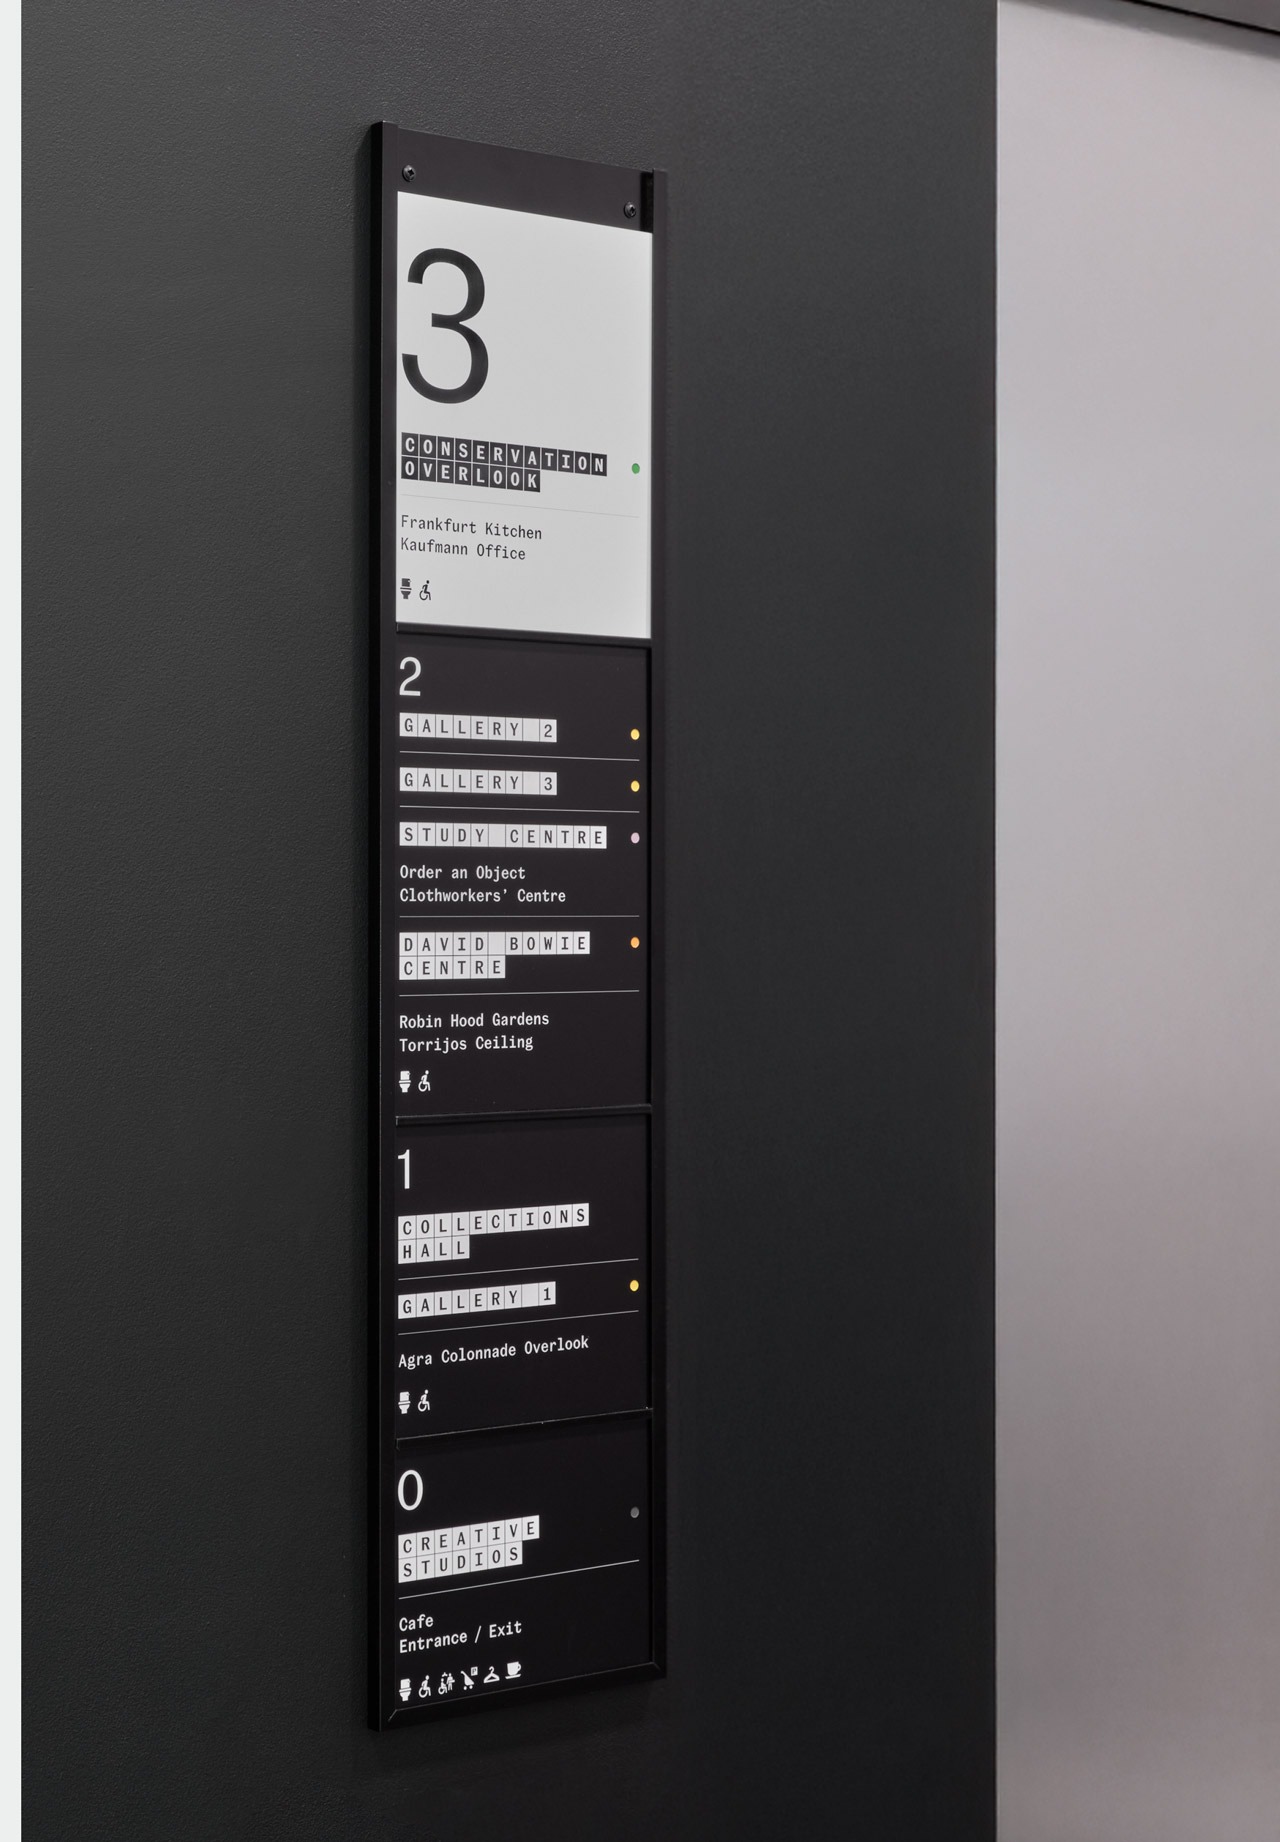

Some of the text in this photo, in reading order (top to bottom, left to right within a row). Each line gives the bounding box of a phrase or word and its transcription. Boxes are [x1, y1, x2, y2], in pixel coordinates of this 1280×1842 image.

[402, 247, 489, 404] 3
[404, 437, 605, 473] CONSERVATION
[404, 461, 538, 488] OVERLOOK
[401, 514, 542, 540] Frankfurt Kitchen
[401, 537, 526, 561] Kaufmann Office
[399, 656, 422, 697] 2
[404, 718, 553, 738] GALLERY 2
[404, 772, 553, 791] GALLERY 3
[404, 827, 602, 845] STUDY CENTRE
[399, 864, 526, 883] Order an Object
[517, 888, 566, 903] Centre
[404, 936, 586, 951] DAVID BOWIE
[404, 960, 501, 975] CENTRE
[399, 1011, 550, 1029] Robin Hood Gardens
[399, 1034, 534, 1054] Torrijos Ceiling
[397, 1149, 411, 1190] 1
[402, 1208, 585, 1235] COLLECTIONS
[403, 1240, 465, 1259] HALL
[402, 1286, 551, 1314] GALLERY 1
[398, 1334, 589, 1370] Agra Colonnade Overlook
[397, 1469, 424, 1511] 0
[403, 1521, 535, 1554] CREATIVE
[403, 1547, 518, 1577] STUDIOS
[399, 1613, 434, 1632] Cafe
[399, 1620, 522, 1654] Entrance / Exit
